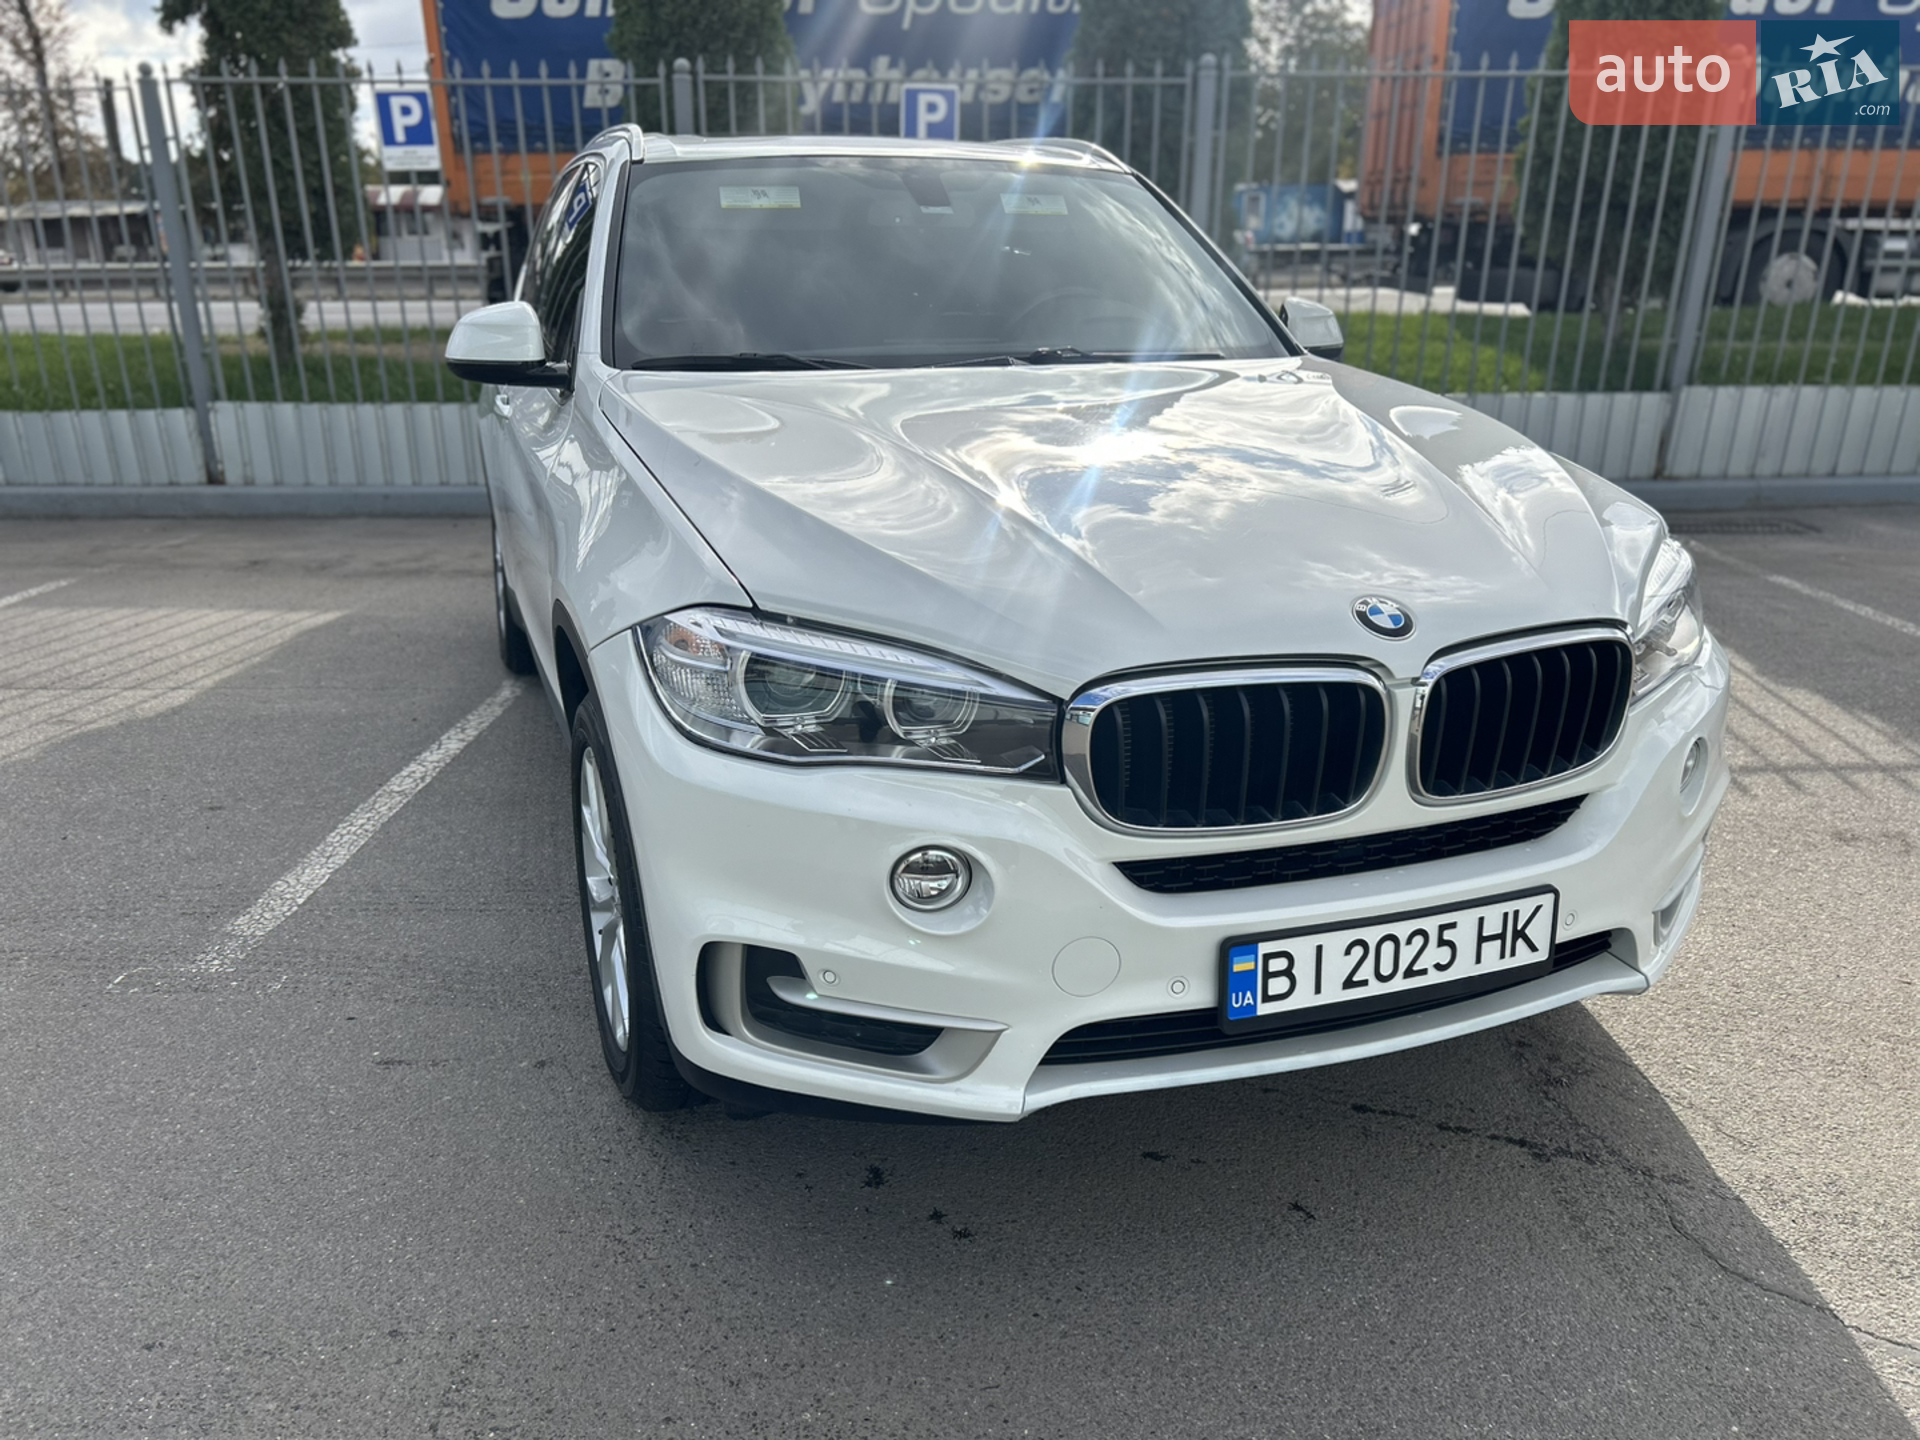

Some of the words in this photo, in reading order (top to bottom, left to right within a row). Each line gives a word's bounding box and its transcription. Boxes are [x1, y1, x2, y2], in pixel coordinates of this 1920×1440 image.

[388, 95, 423, 144] P
[917, 92, 948, 139] P
[1261, 944, 1323, 1004] BI
[1342, 921, 1458, 991] 2025
[1475, 904, 1544, 965] HK
[1232, 990, 1254, 1008] UA
